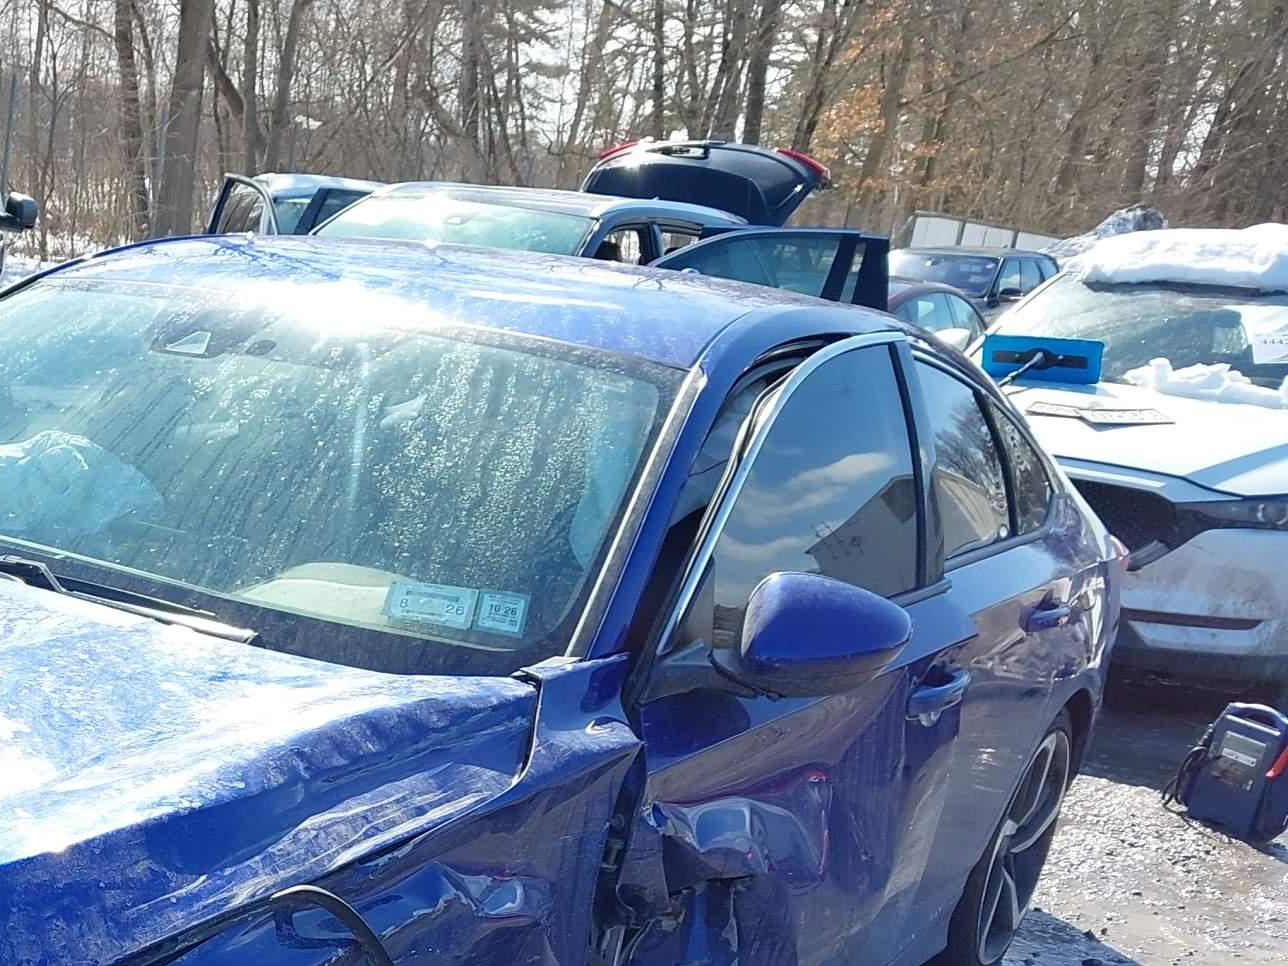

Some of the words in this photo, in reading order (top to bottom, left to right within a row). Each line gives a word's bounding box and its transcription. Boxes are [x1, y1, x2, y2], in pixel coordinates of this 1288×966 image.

[399, 598, 409, 608] 8
[445, 605, 465, 616] 26
[489, 603, 501, 612] 10
[503, 606, 517, 616] 26
